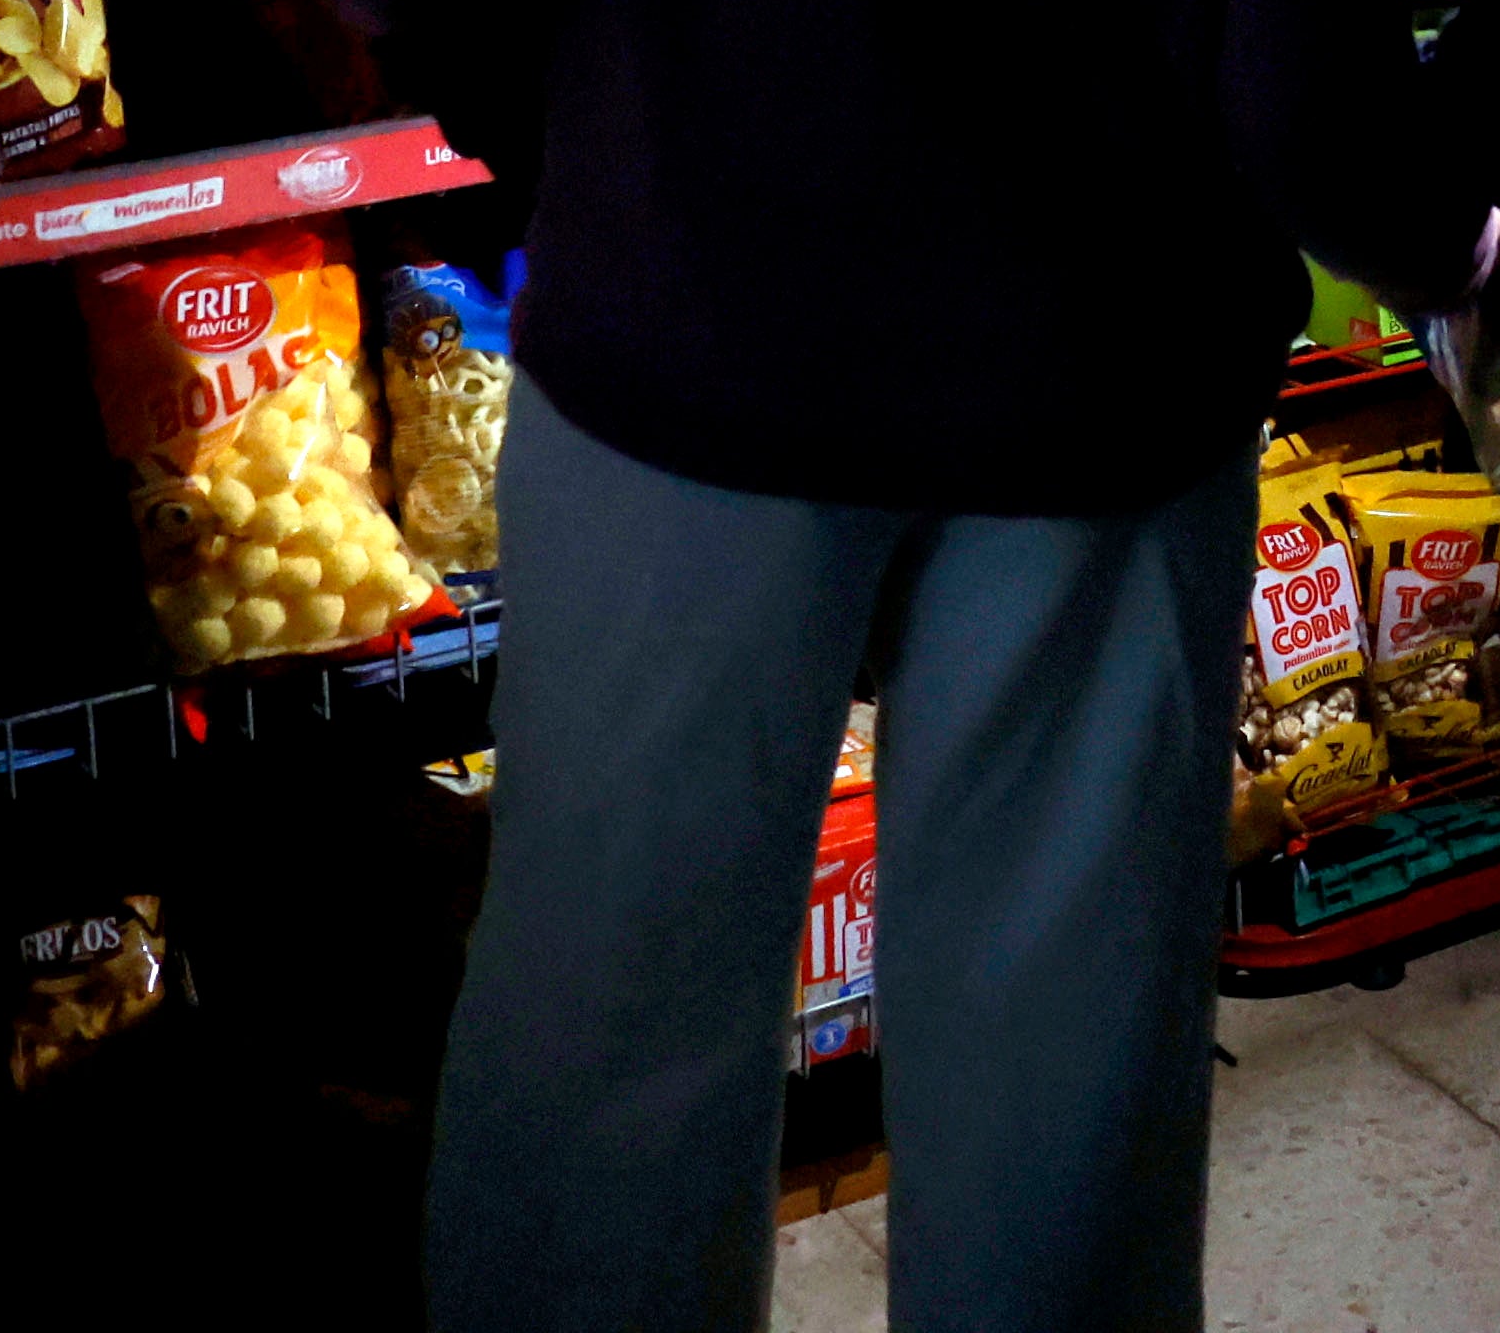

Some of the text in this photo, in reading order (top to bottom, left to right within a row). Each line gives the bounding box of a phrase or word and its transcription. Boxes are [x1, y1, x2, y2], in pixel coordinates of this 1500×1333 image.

[113, 179, 215, 218] momentos
[177, 281, 258, 324] FRIT
[187, 316, 251, 340] RAVICH
[1263, 525, 1308, 554] FRIT
[1276, 545, 1311, 564] RAVICH
[1418, 539, 1473, 560] FRIT
[1423, 559, 1467, 571] RAVICH
[1262, 566, 1341, 625] TOP
[1396, 581, 1485, 623] TOP
[1272, 604, 1351, 656] CORN
[1284, 644, 1333, 672] palomitas
[1292, 659, 1349, 692] CACAOLAT
